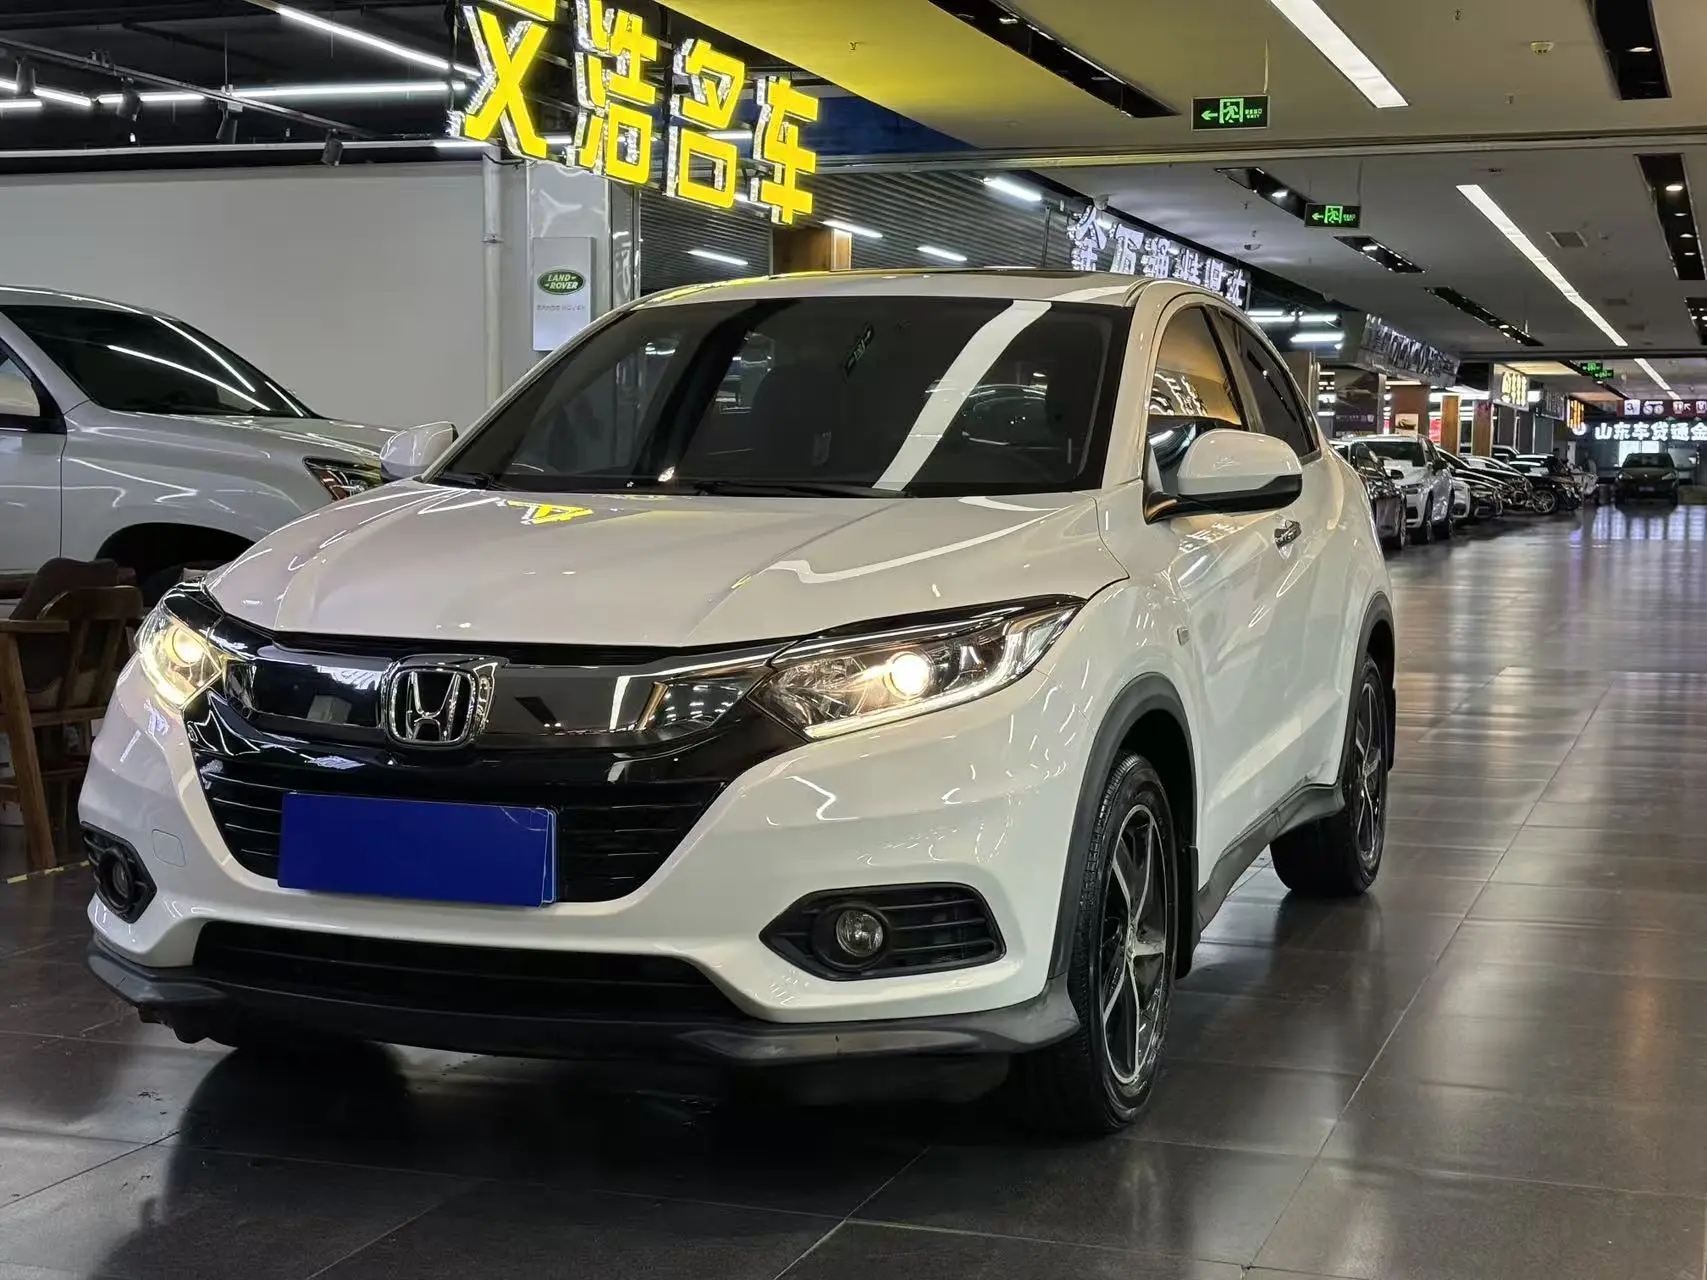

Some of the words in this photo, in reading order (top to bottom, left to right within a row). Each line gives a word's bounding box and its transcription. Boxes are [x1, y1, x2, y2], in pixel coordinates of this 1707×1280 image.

[1594, 421, 1707, 441] 山东车贷通金
